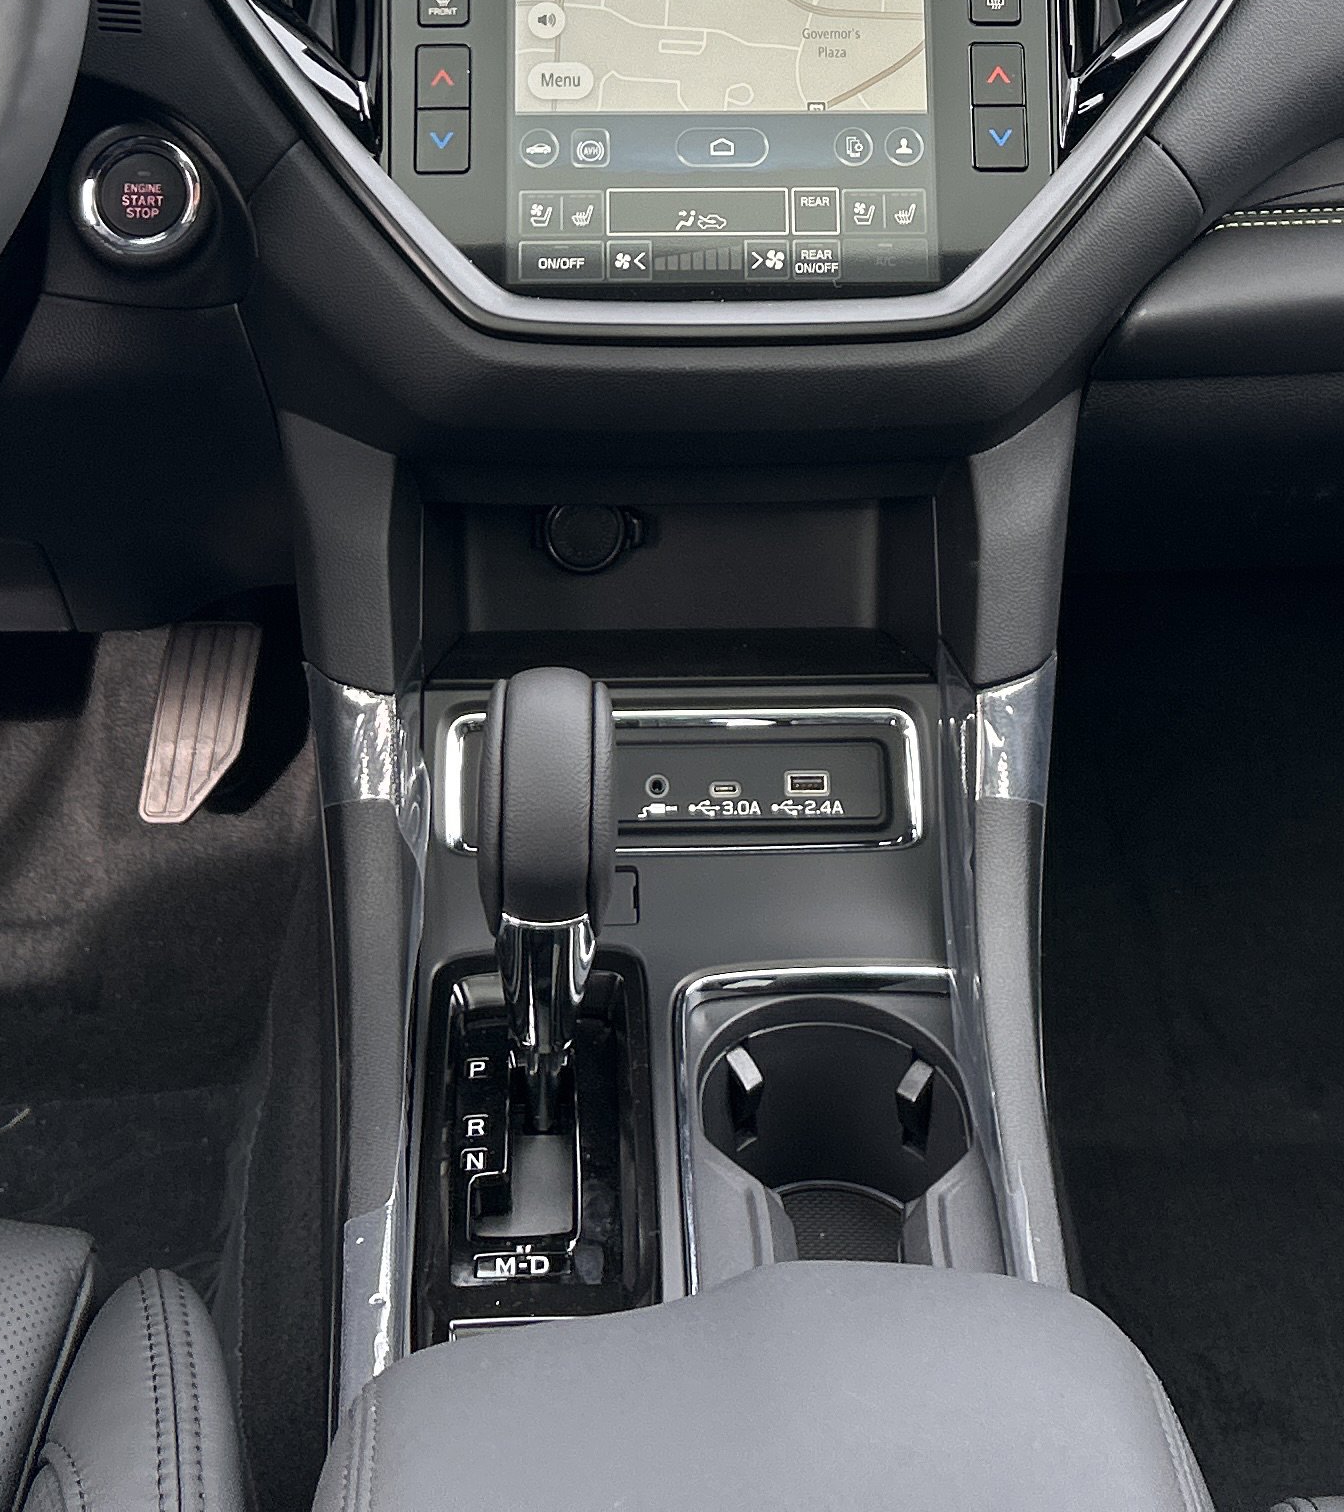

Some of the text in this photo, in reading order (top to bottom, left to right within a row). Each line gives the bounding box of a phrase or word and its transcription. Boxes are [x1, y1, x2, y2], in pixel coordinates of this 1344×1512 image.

[428, 7, 458, 16] FRONT
[802, 28, 861, 40] Governor's
[818, 46, 847, 59] Plaza
[541, 73, 581, 88] Menu
[123, 183, 162, 193] ENGINE
[121, 194, 164, 206] START
[800, 196, 830, 207] REAR
[126, 207, 160, 219] STOP
[800, 250, 833, 260] REAR
[538, 257, 585, 270] ON/OFF
[794, 262, 839, 274] ON/OFF
[722, 800, 844, 815] 3.0A 2.4A
[469, 1062, 486, 1078] P
[467, 1118, 485, 1136] R
[466, 1152, 484, 1170] N
